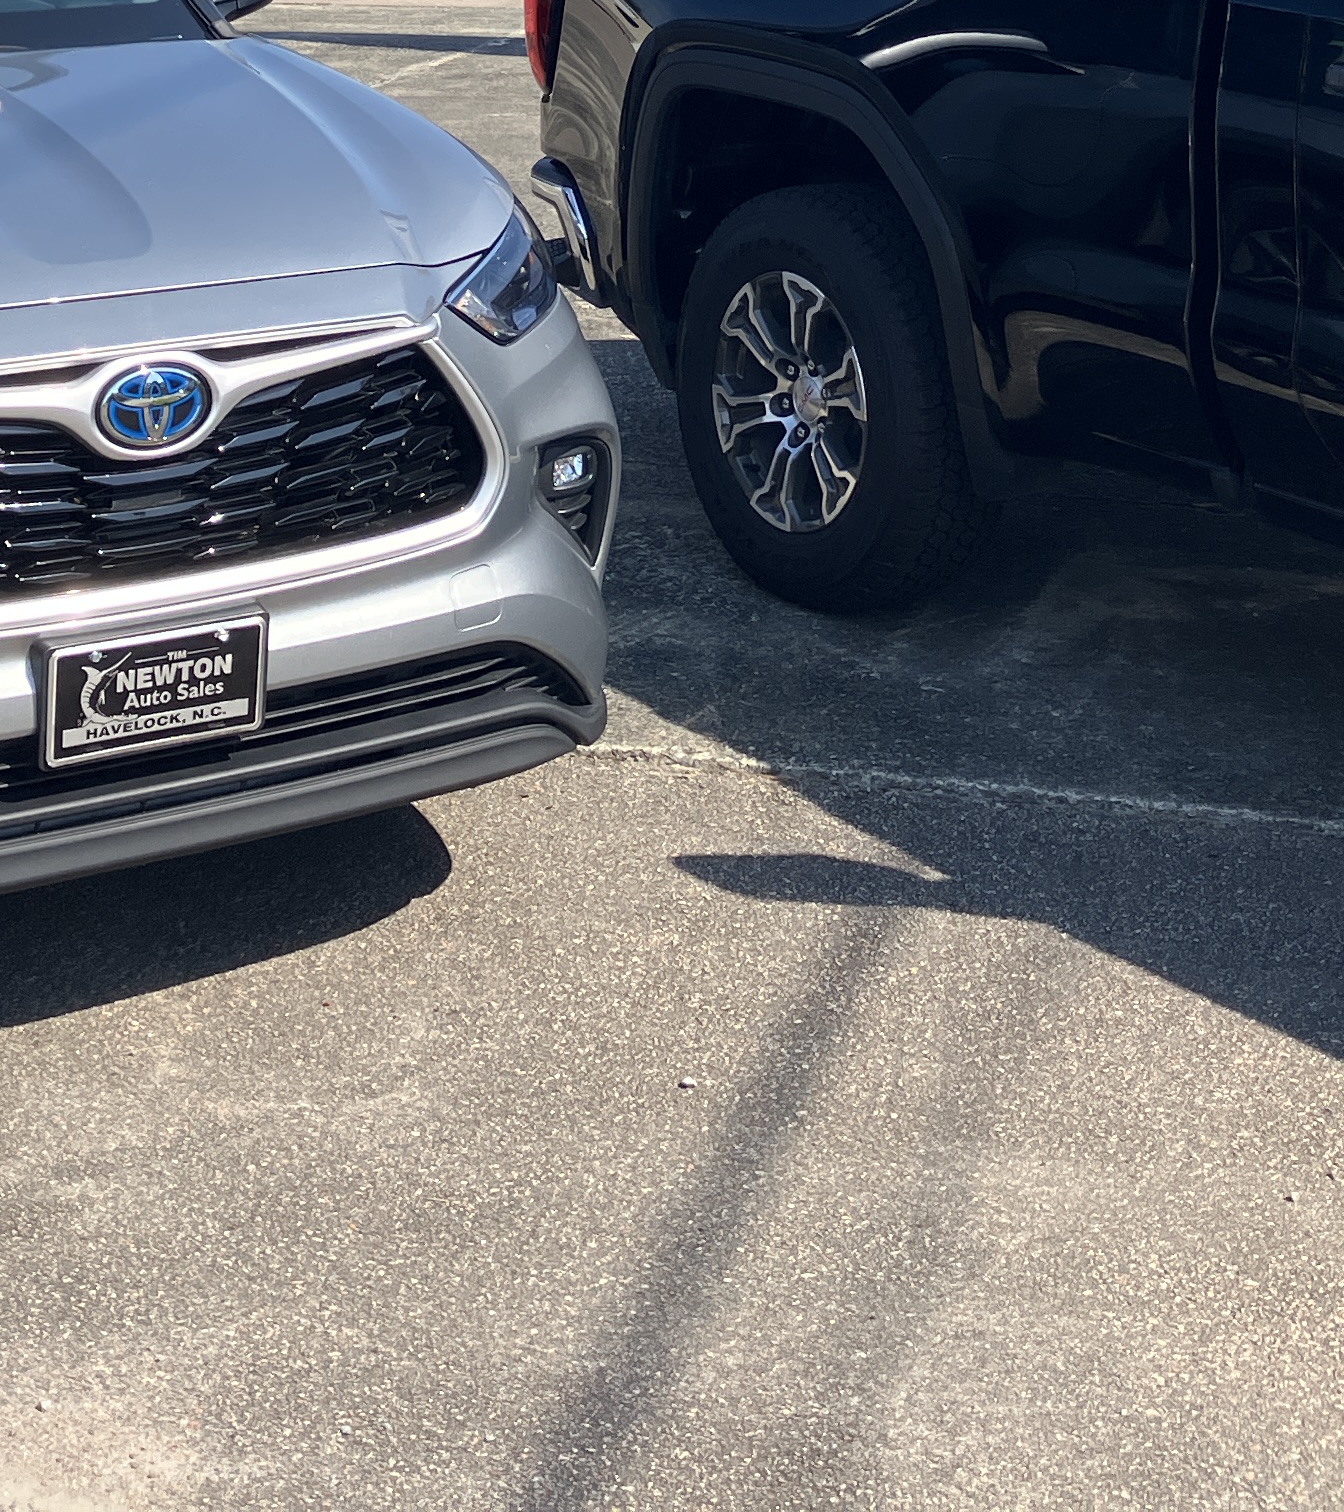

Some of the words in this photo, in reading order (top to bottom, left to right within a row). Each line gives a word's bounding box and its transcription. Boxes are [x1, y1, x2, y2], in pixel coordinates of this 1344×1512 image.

[168, 651, 187, 661] TIM
[116, 654, 233, 693] NEWTON
[124, 689, 171, 710] Auto
[177, 681, 224, 700] Sales
[86, 715, 186, 740] HAVELOCK,
[192, 706, 226, 723] N.C.
